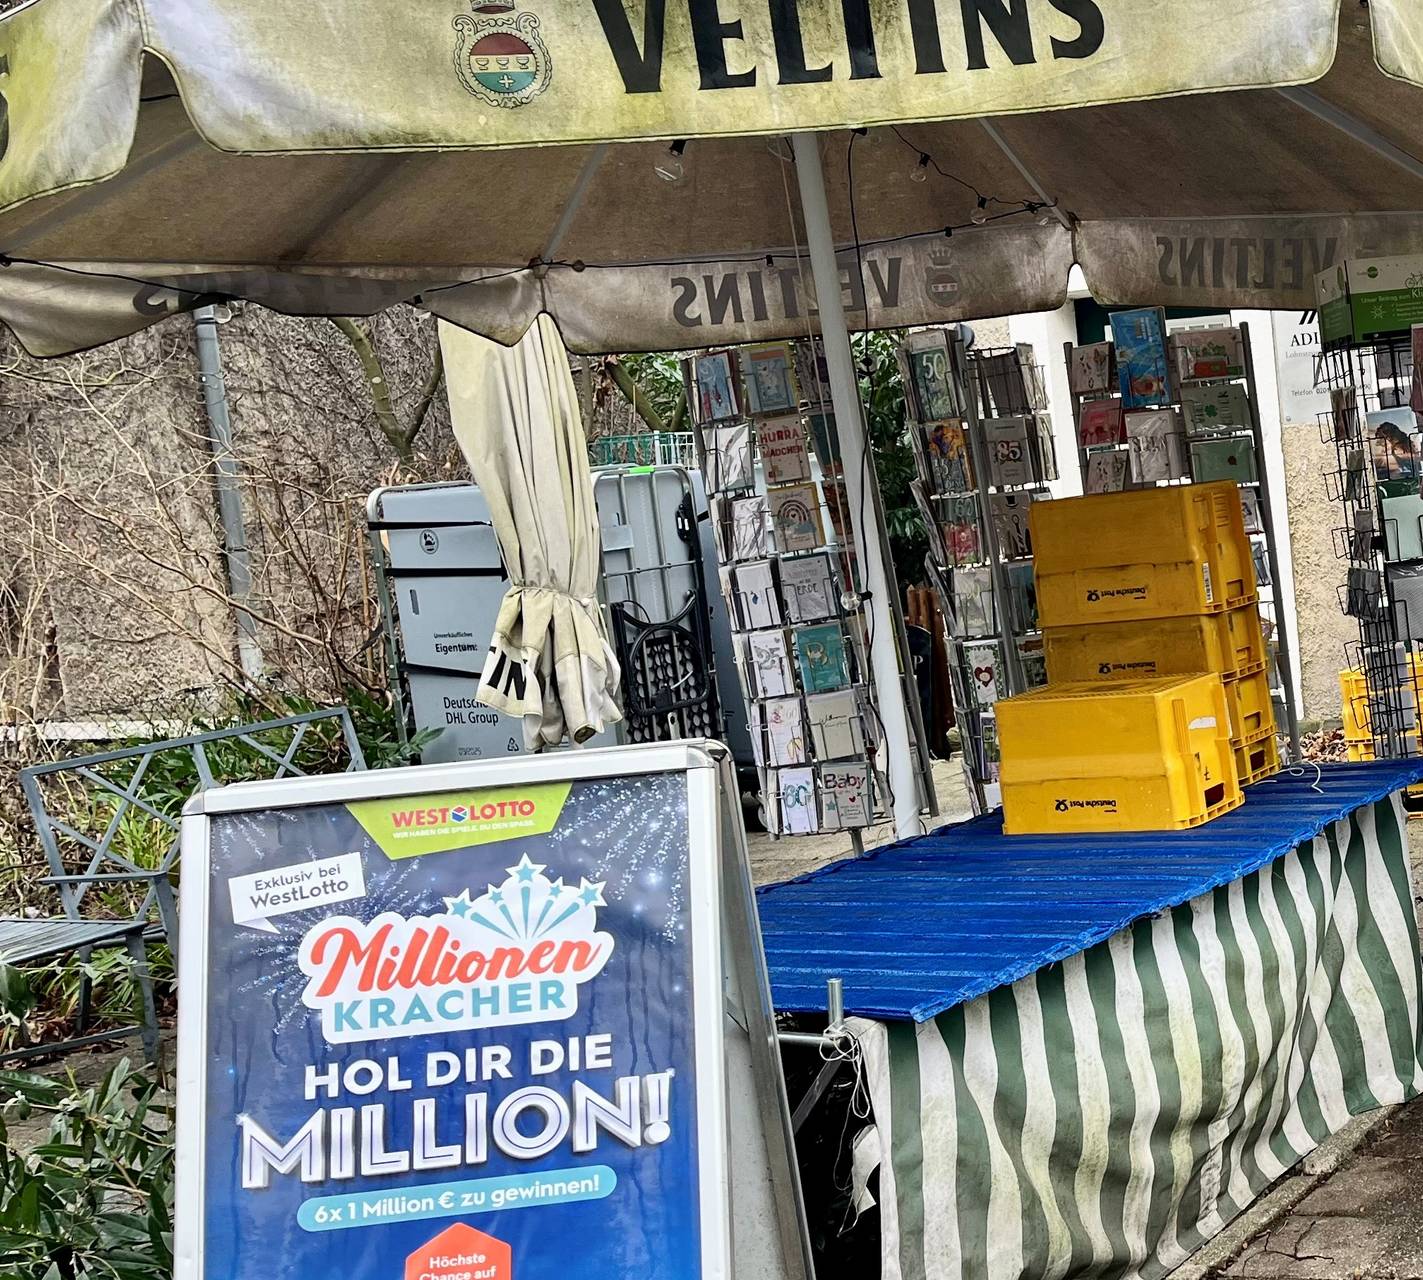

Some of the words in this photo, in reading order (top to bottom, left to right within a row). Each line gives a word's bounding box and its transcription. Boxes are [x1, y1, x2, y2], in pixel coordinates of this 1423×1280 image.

[922, 352, 946, 380] 50
[760, 428, 800, 444] HURRA
[435, 643, 478, 655] Eigentum:
[446, 711, 466, 724] DHL
[468, 711, 499, 726] Group
[823, 771, 866, 790] Baby
[392, 807, 449, 828] WEST
[470, 799, 535, 821] LOTTO
[1070, 800, 1085, 808] Post
[1085, 800, 1117, 808] Deutsche
[254, 869, 313, 892] Exklusiv
[318, 863, 341, 878] bei
[249, 876, 349, 910] WestLotto
[310, 924, 603, 998] Millionen
[334, 979, 567, 1033] KRACHER
[304, 1055, 412, 1101] HOL
[426, 1044, 513, 1088] DIR
[530, 1033, 614, 1076] DIE
[240, 1071, 673, 1190] MILLION!
[314, 1203, 343, 1225] 6x
[347, 1200, 358, 1221] 1
[362, 1191, 434, 1220] Million
[438, 1191, 455, 1209] €
[460, 1191, 485, 1206] zu
[491, 1174, 599, 1209] gewinnen!
[429, 1252, 487, 1270] Höchste
[475, 1266, 496, 1280] auf
